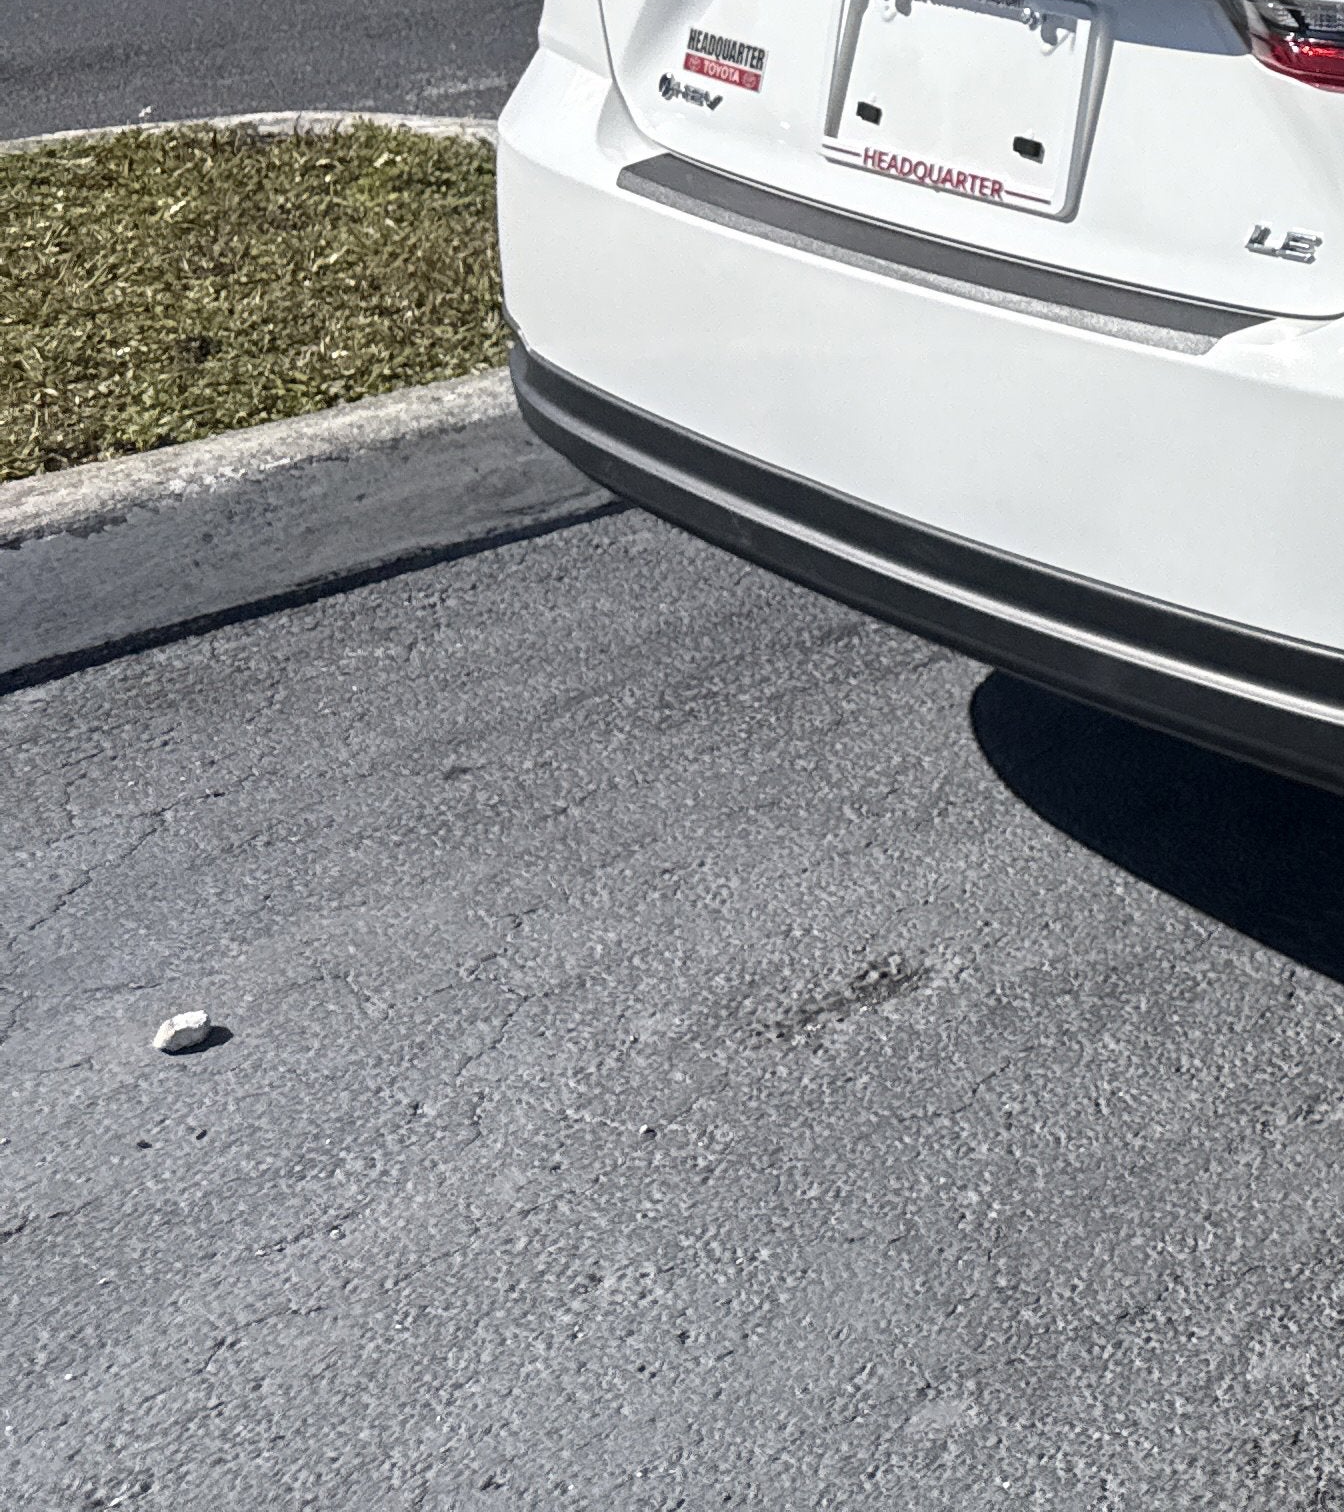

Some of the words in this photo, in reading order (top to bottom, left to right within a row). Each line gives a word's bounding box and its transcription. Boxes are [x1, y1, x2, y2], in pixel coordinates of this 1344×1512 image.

[687, 27, 766, 72] HEADQUARTER
[703, 59, 740, 85] TOYOTA
[862, 146, 1005, 201] HEADQUARTER
[1244, 223, 1324, 265] LE
